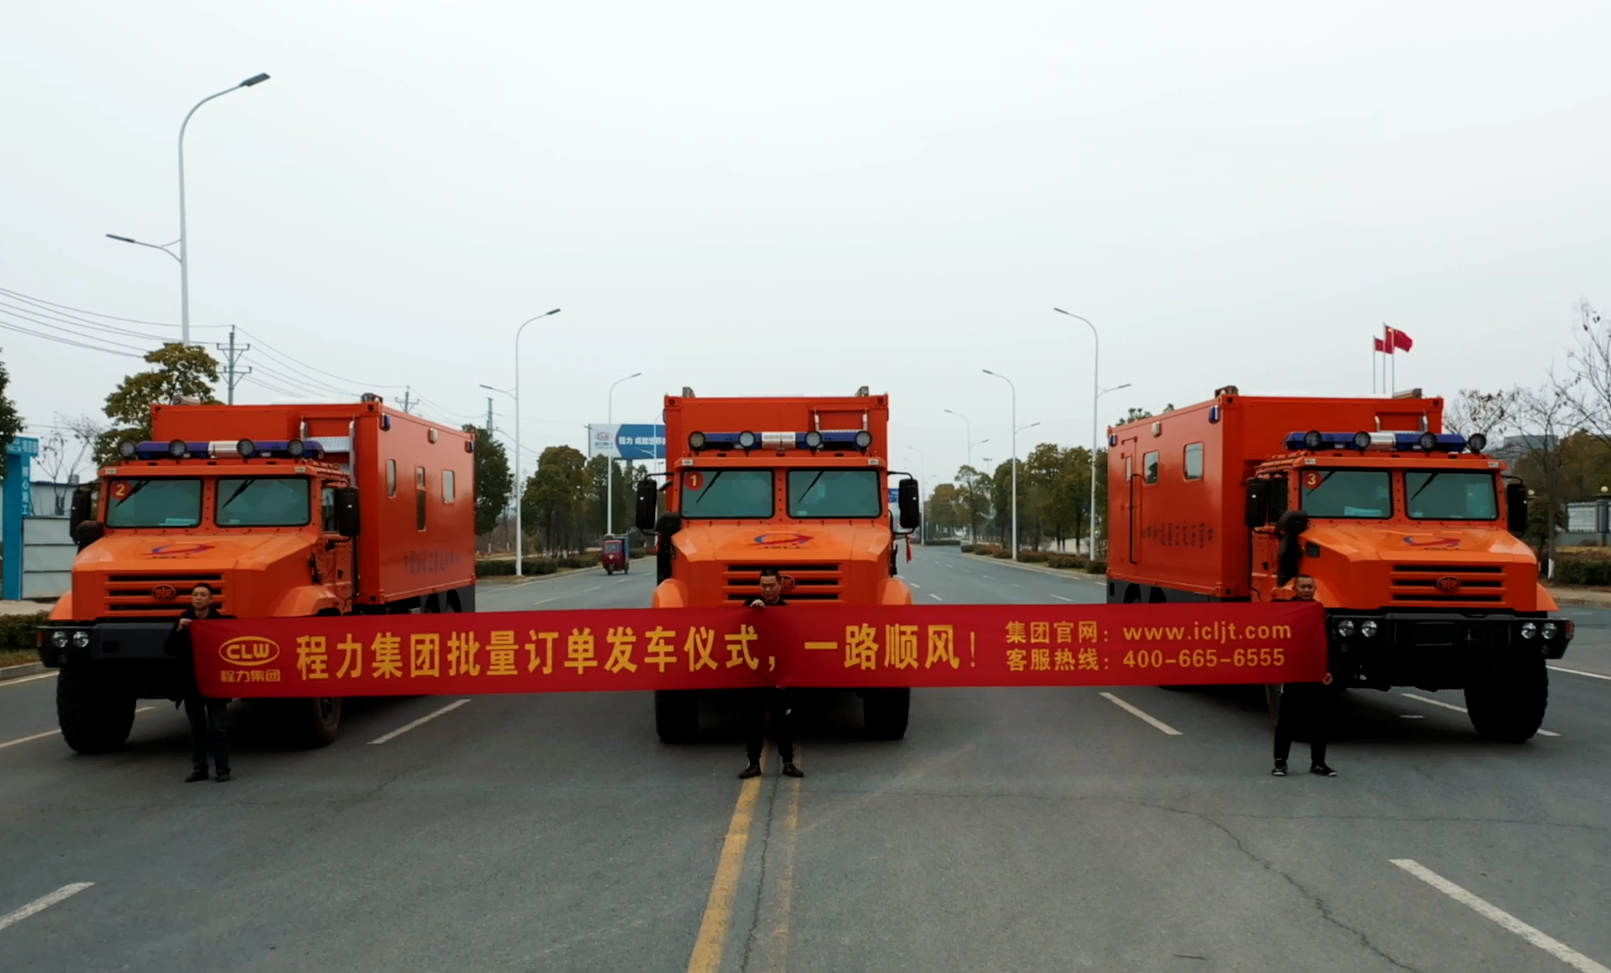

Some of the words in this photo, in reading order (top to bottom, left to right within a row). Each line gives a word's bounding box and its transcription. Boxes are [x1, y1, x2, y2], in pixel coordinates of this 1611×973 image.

[690, 475, 697, 487] 1
[1307, 473, 1316, 486] 3
[115, 484, 125, 496] 2
[1123, 621, 1292, 644] www.icljt.com
[226, 643, 270, 660] CLW
[1123, 648, 1286, 668] 400-665-6555
[220, 669, 281, 682] 程力集团
